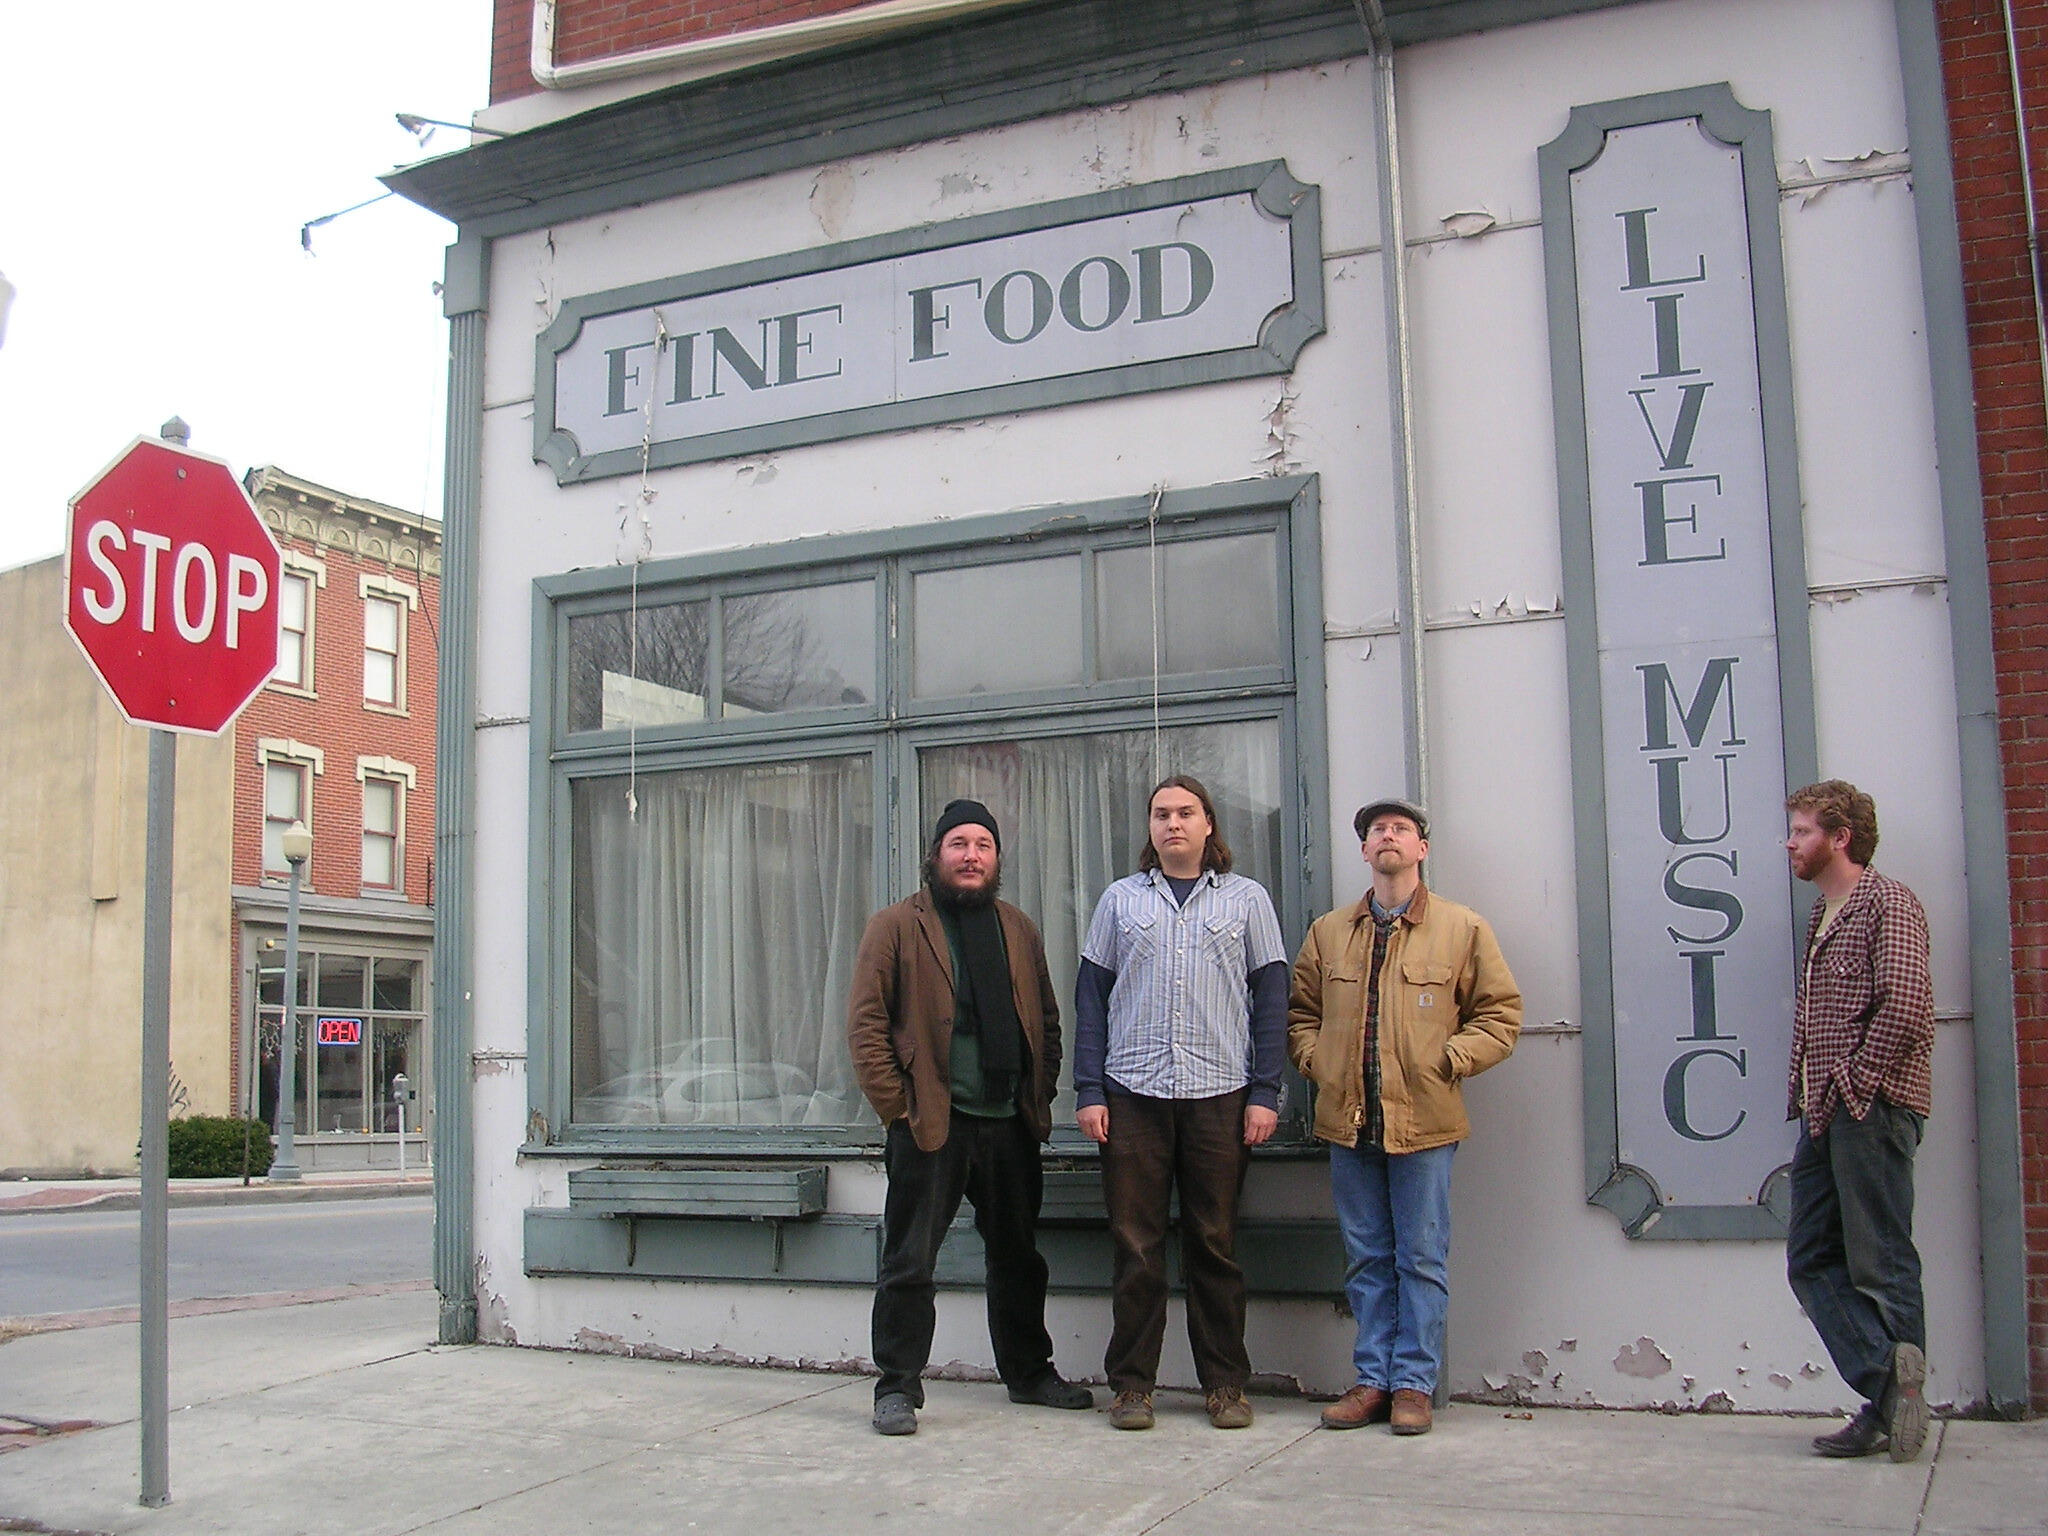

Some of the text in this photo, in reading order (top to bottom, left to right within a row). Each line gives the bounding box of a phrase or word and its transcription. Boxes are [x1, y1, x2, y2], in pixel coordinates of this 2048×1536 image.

[603, 241, 1215, 418] FINE FOOD
[83, 519, 268, 649] STOP
[1615, 206, 1746, 1141] LIVE MUSIC
[320, 1021, 359, 1042] OPEN
